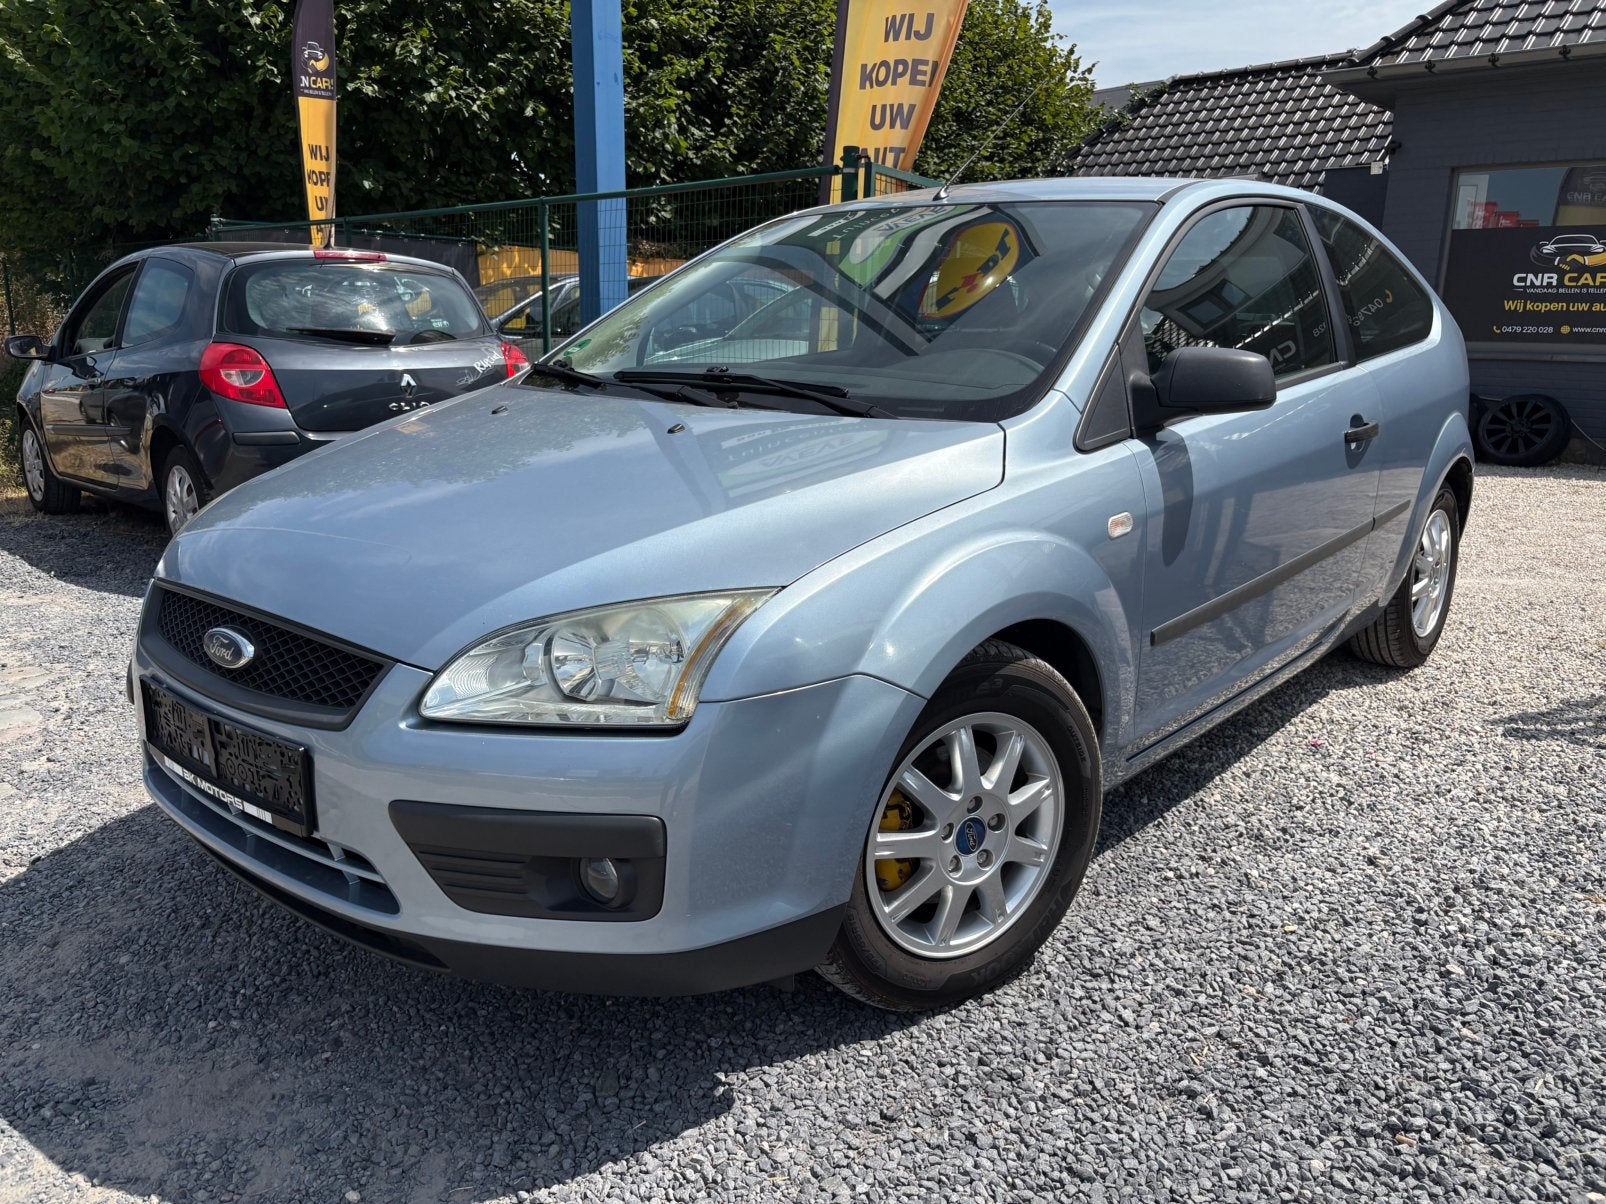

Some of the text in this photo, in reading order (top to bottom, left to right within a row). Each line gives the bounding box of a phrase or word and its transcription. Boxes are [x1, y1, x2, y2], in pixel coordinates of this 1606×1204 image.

[884, 13, 935, 43] WIJ
[869, 103, 916, 131] UW
[308, 143, 330, 162] WIJ
[1512, 273, 1558, 286] CNR
[1504, 300, 1525, 313] Wij
[1526, 301, 1567, 313] kopen
[1569, 303, 1590, 311] uw
[1538, 326, 1554, 334] 028
[209, 634, 234, 661] Ford
[197, 777, 243, 810] MOTORS
